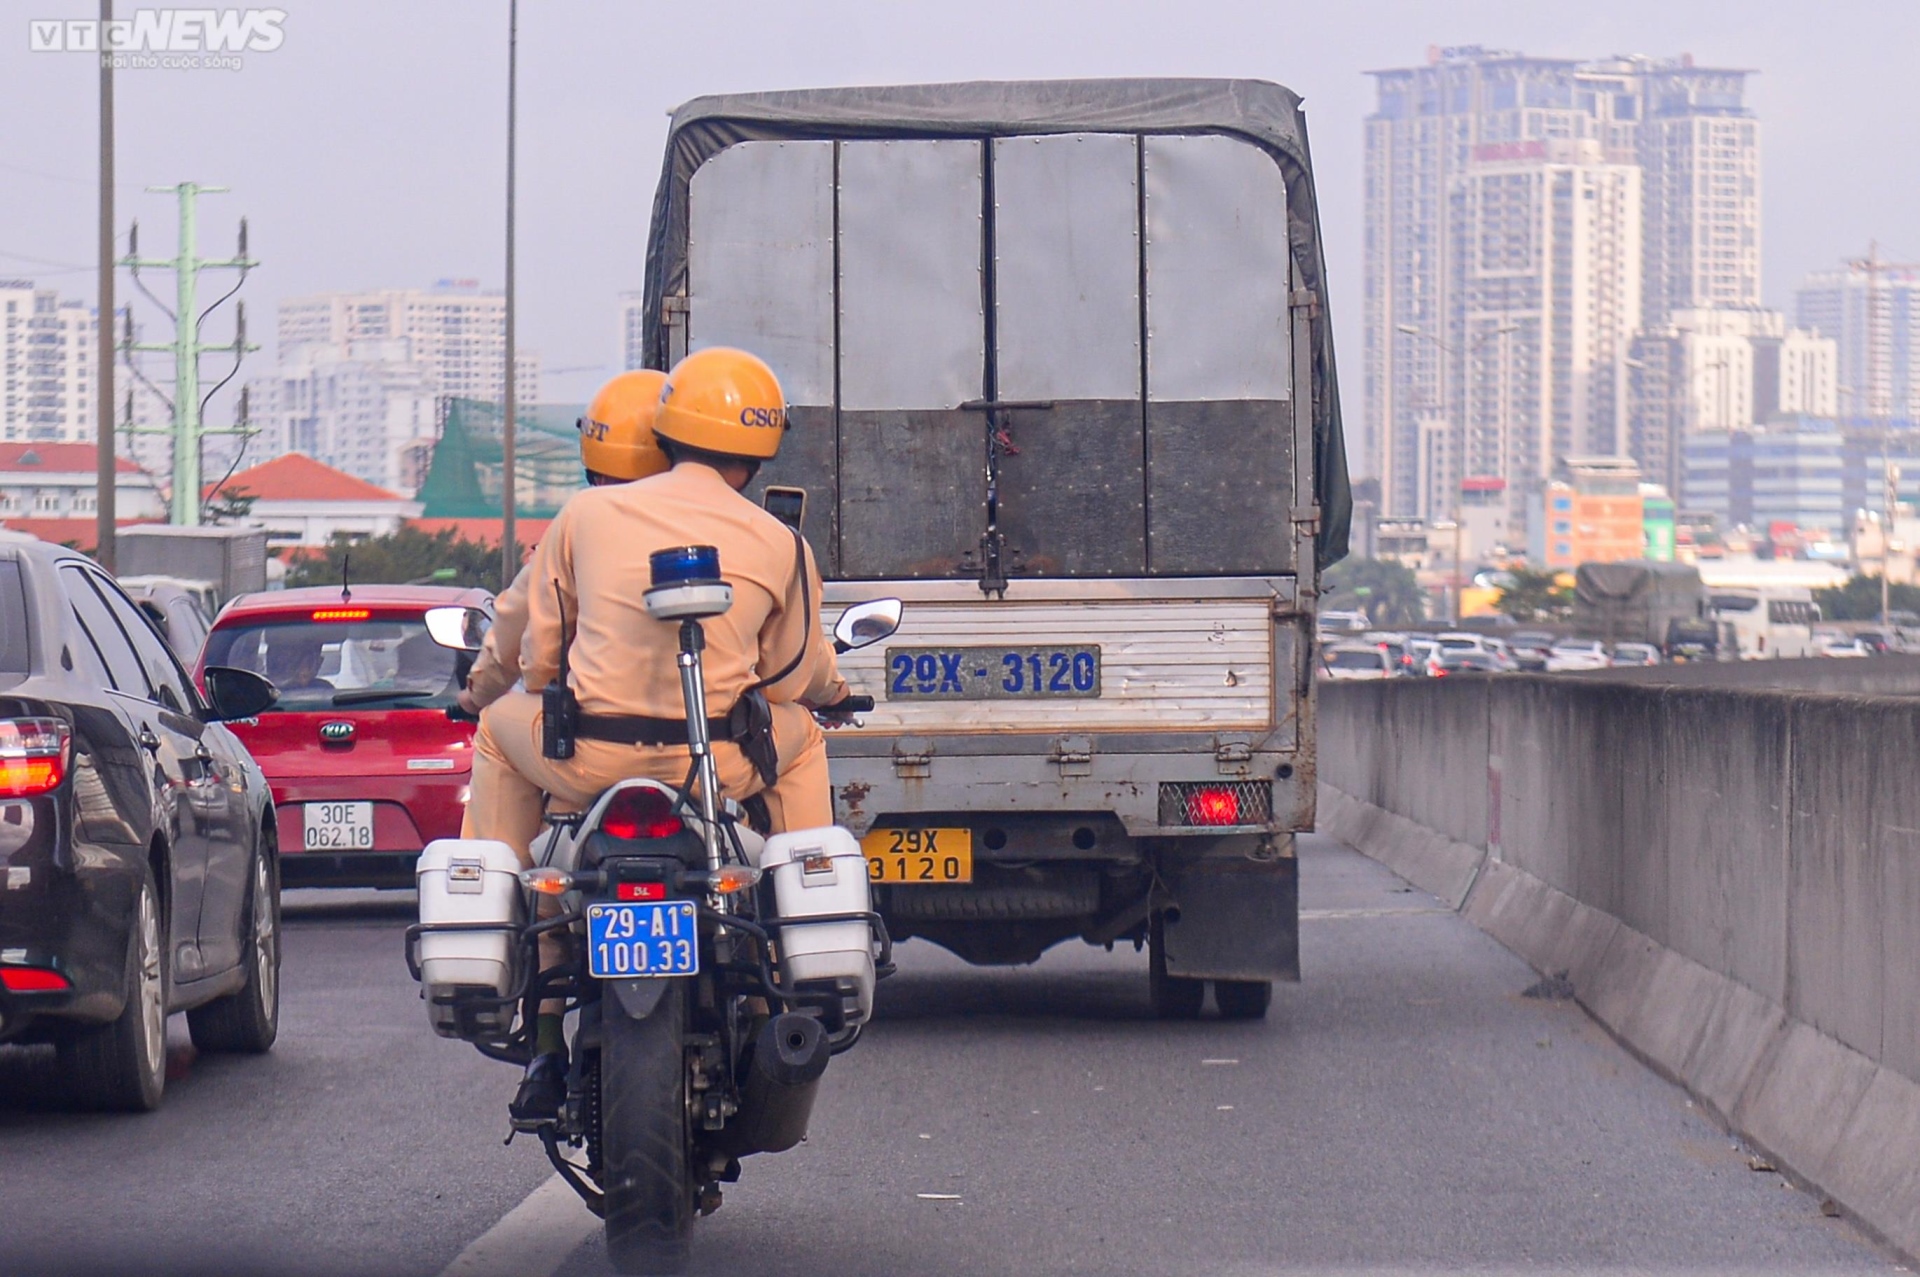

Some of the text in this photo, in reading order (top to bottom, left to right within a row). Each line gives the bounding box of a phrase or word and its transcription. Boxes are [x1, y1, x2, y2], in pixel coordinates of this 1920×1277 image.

[892, 654, 963, 693] 29X
[1002, 652, 1095, 692] 3120
[325, 725, 348, 737] KIA
[321, 804, 356, 825] 30E
[307, 826, 370, 847] 062.18
[889, 830, 938, 853] 29X
[869, 856, 960, 880] 3120
[598, 939, 691, 973] 100.33
